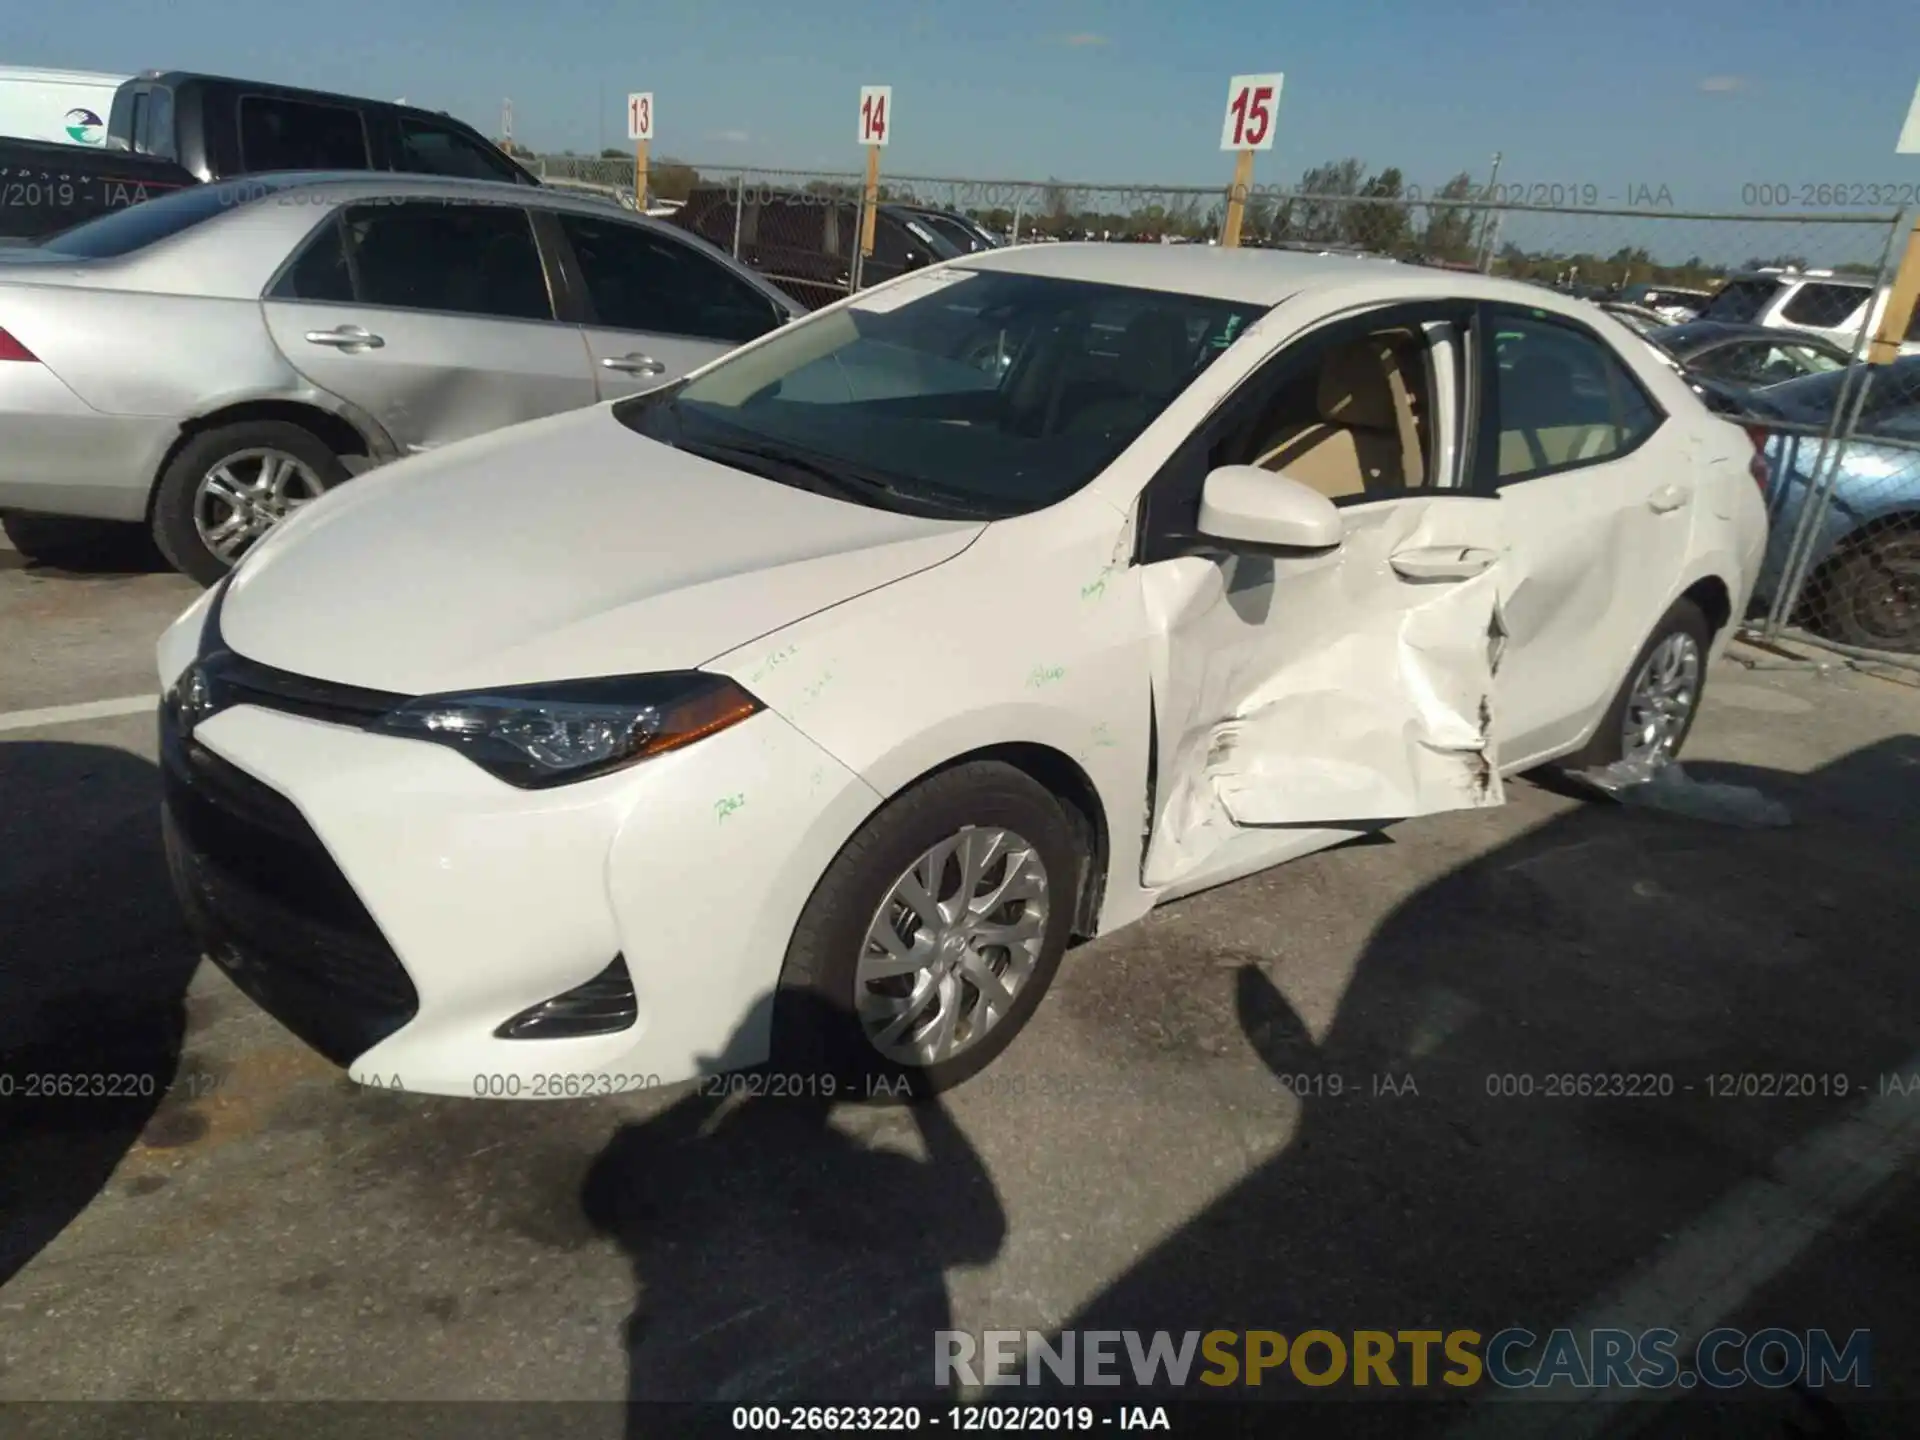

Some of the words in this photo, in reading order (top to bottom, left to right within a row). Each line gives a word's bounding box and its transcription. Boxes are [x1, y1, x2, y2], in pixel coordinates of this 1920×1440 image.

[631, 98, 649, 134] 13
[862, 95, 886, 140] 14
[1231, 86, 1273, 145] 15
